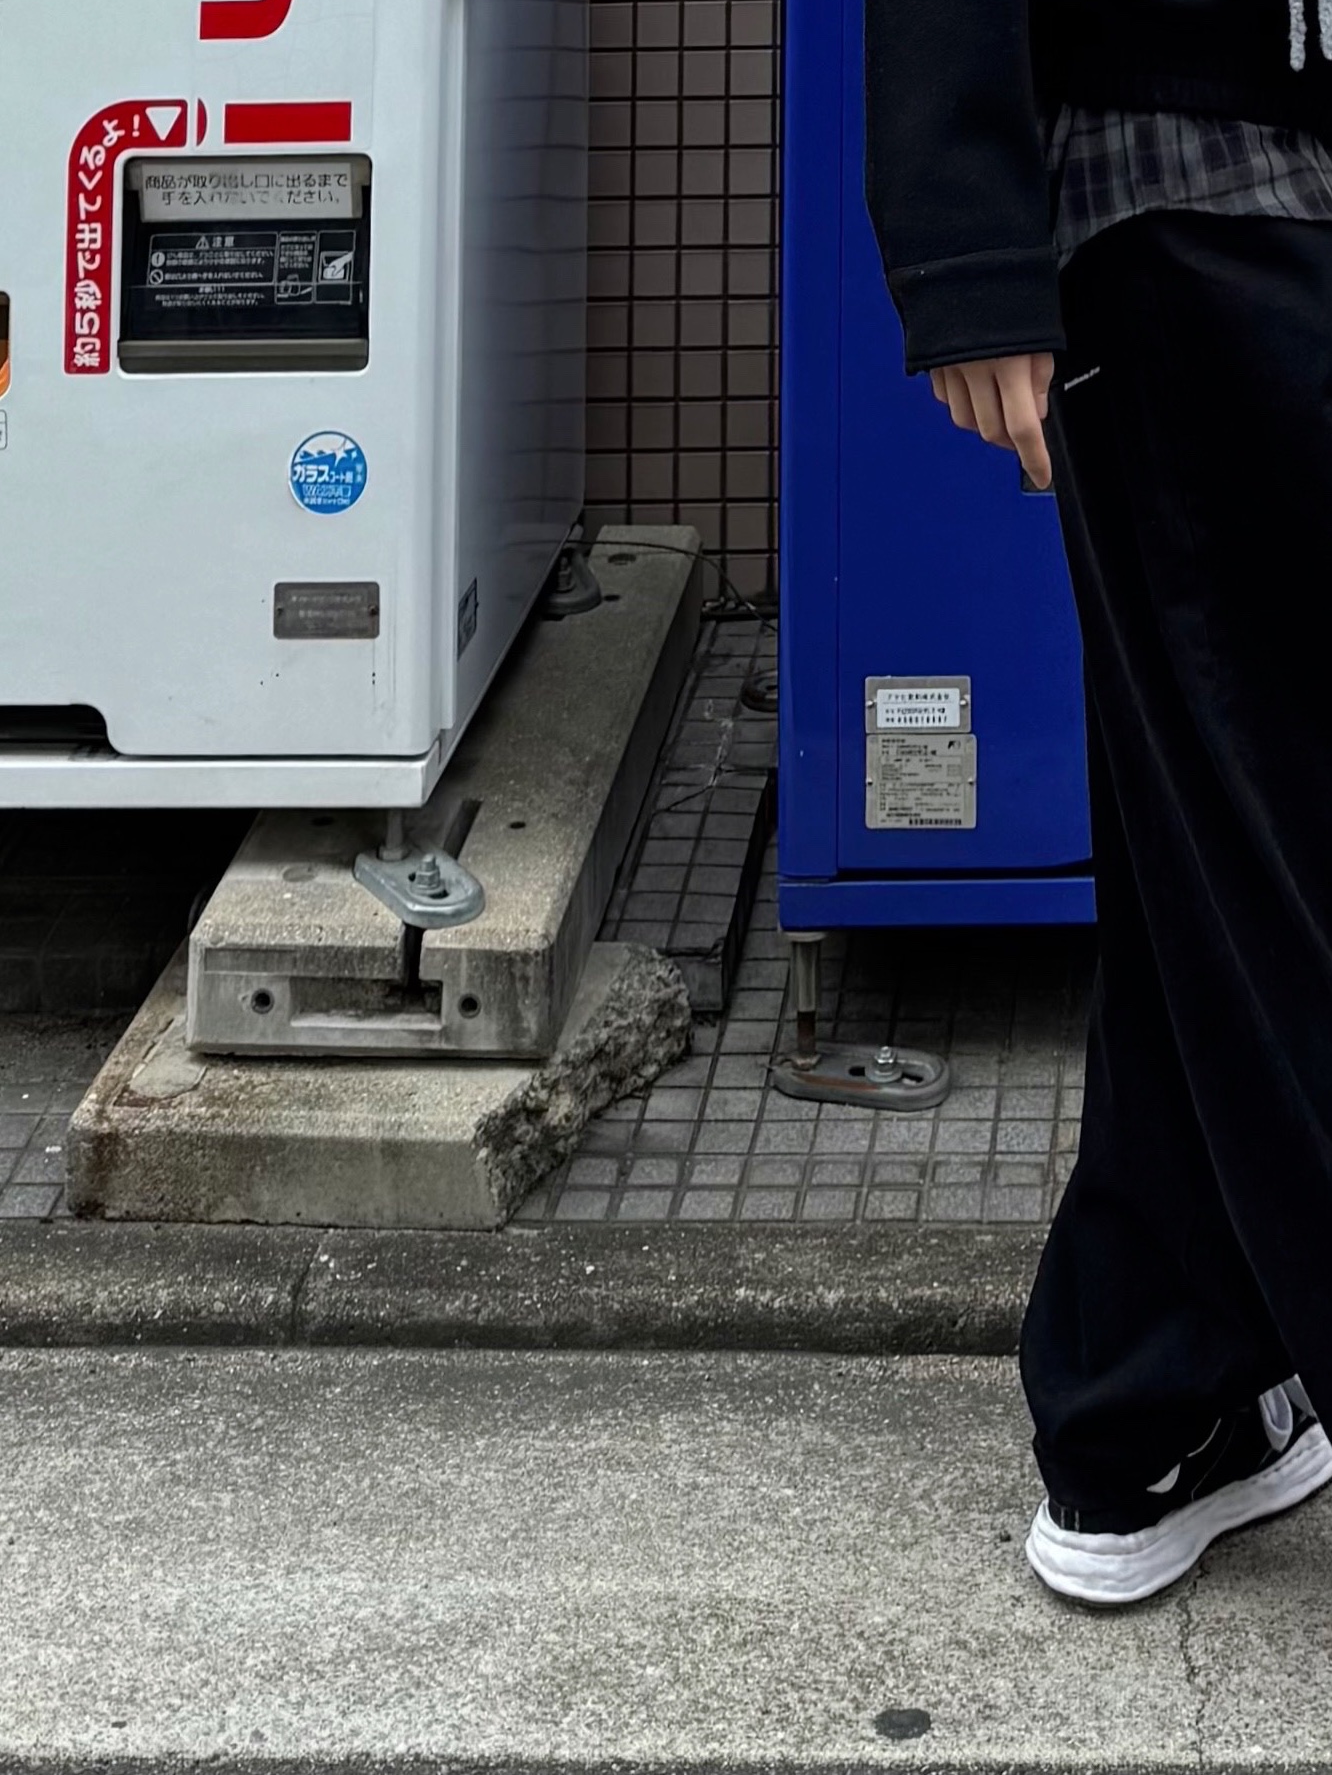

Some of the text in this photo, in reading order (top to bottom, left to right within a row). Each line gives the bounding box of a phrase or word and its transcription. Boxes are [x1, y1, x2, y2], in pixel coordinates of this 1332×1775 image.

[145, 172, 349, 190] 商品が取り出し口に出るまで
